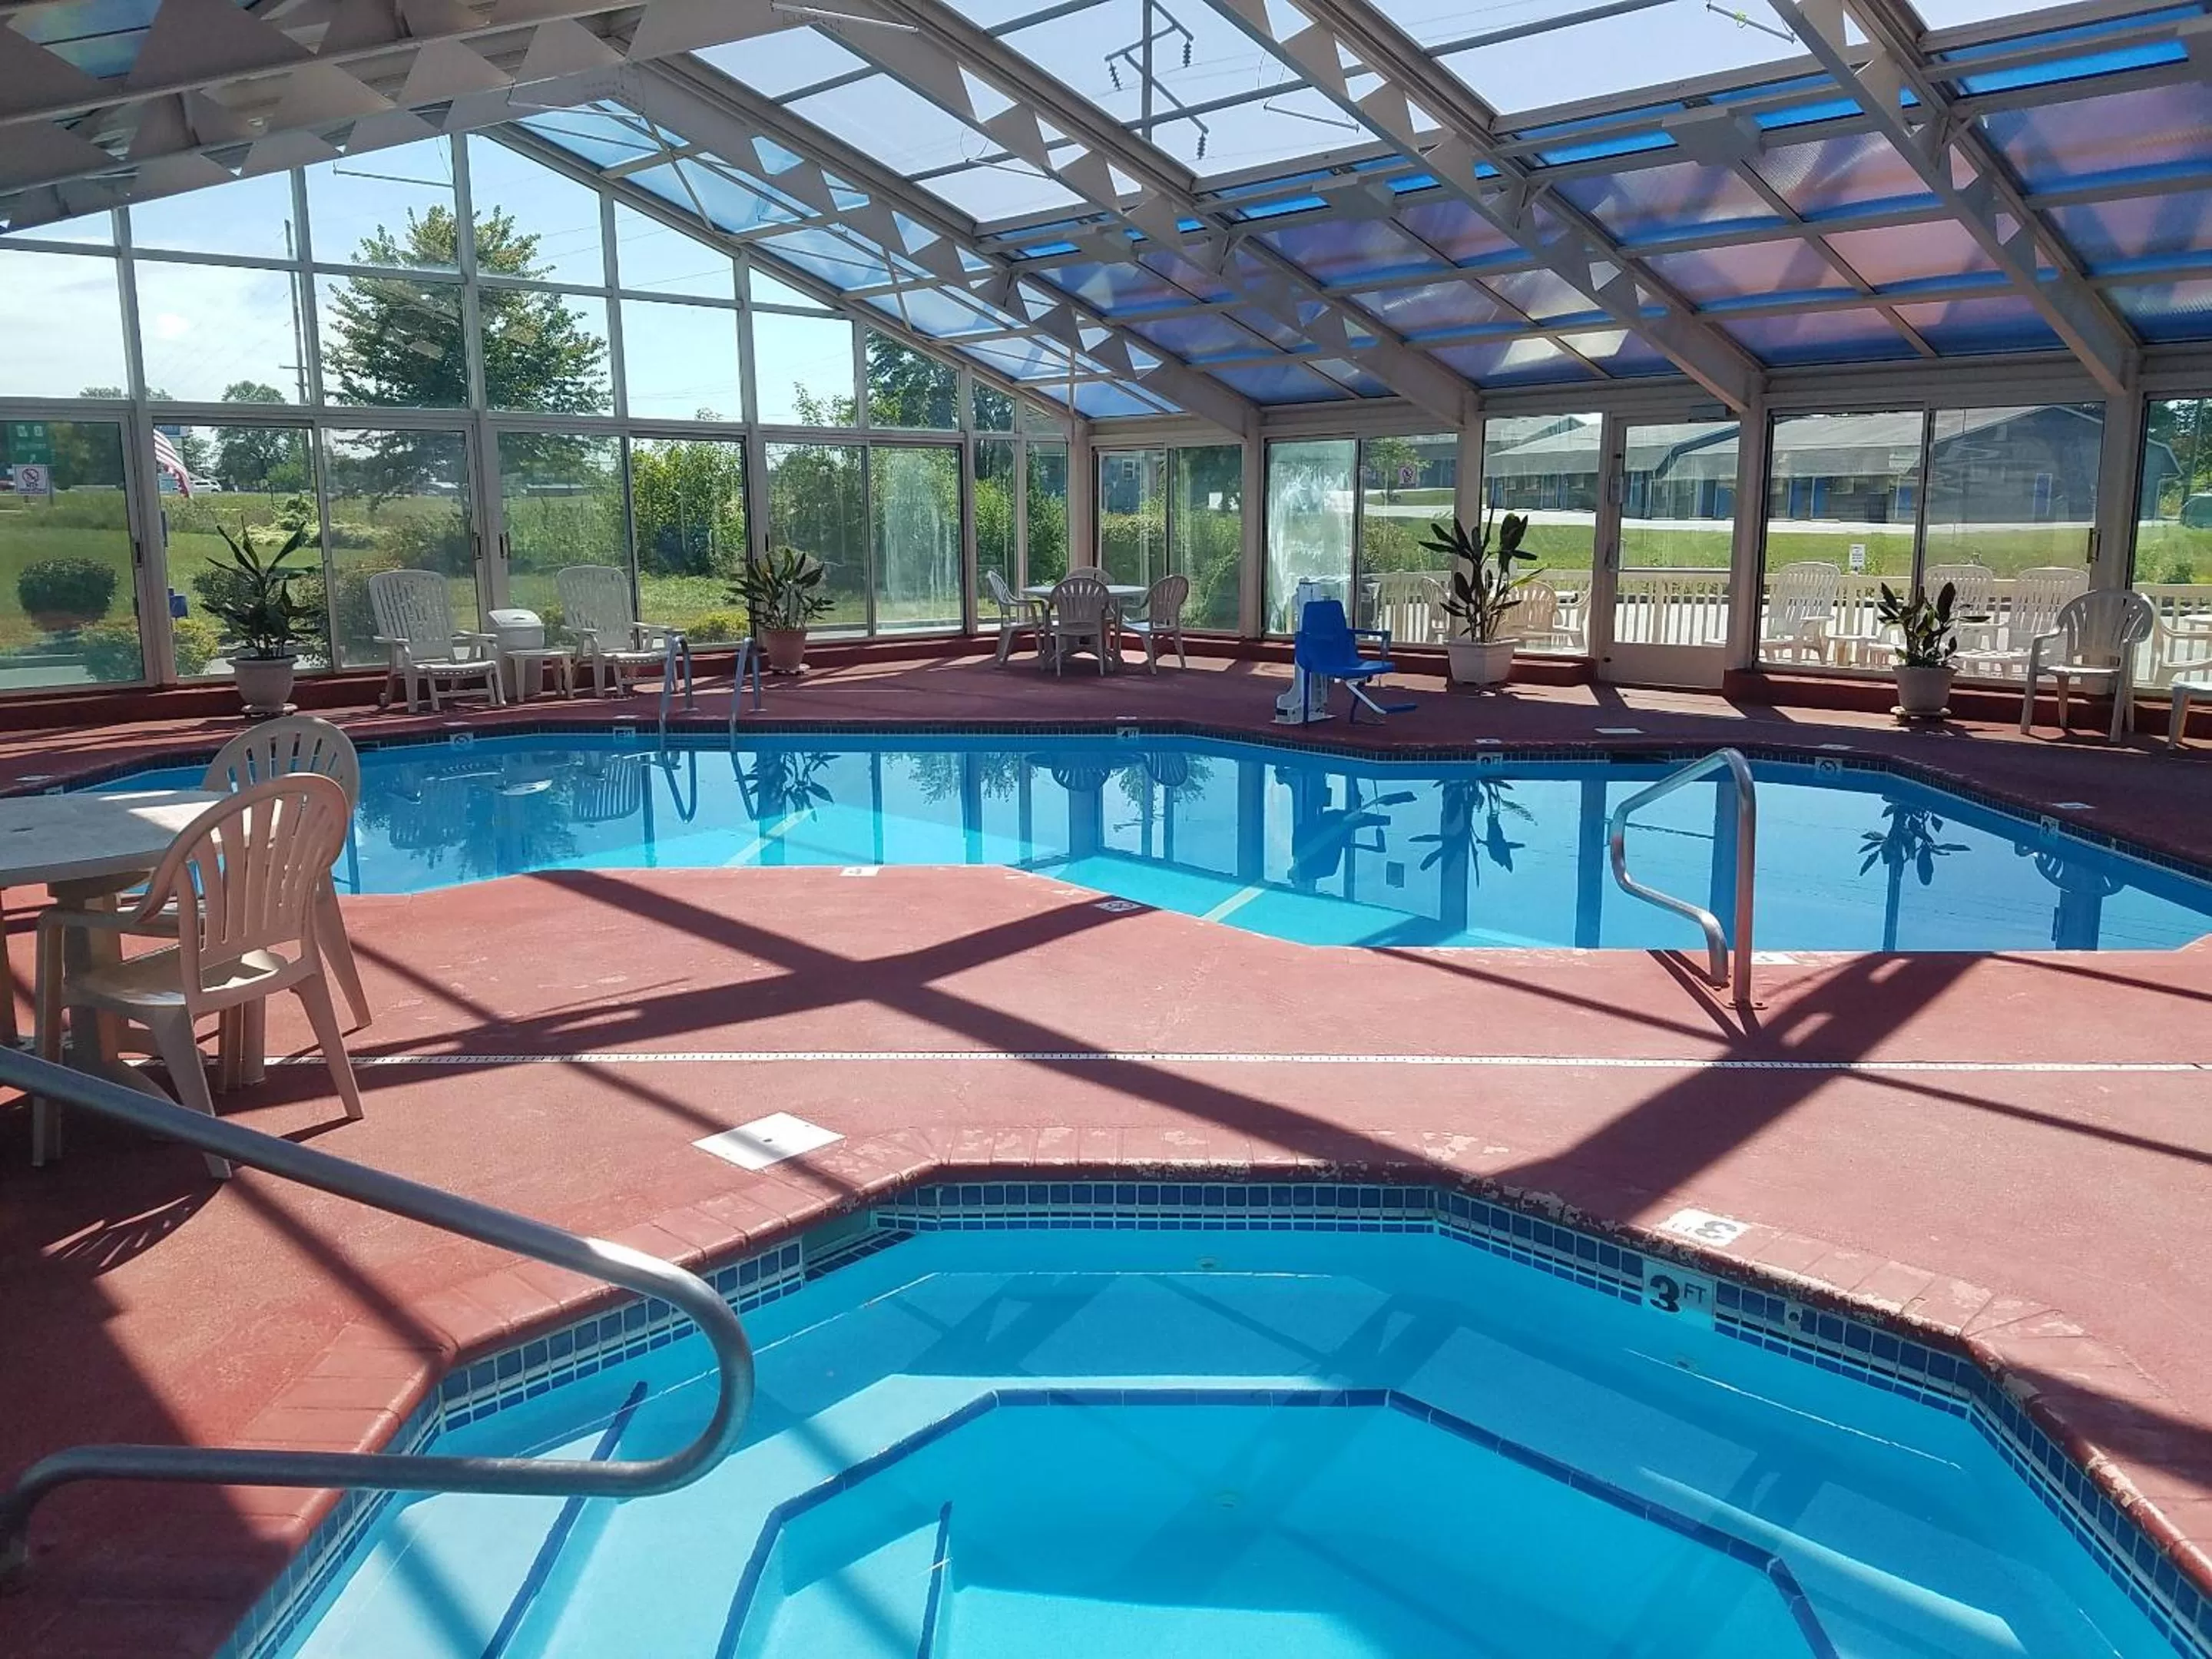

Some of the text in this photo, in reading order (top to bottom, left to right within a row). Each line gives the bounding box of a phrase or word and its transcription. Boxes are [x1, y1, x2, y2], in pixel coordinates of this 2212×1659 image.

[1694, 1220, 1737, 1239] 3
[1649, 1274, 1707, 1313] 3 FT
